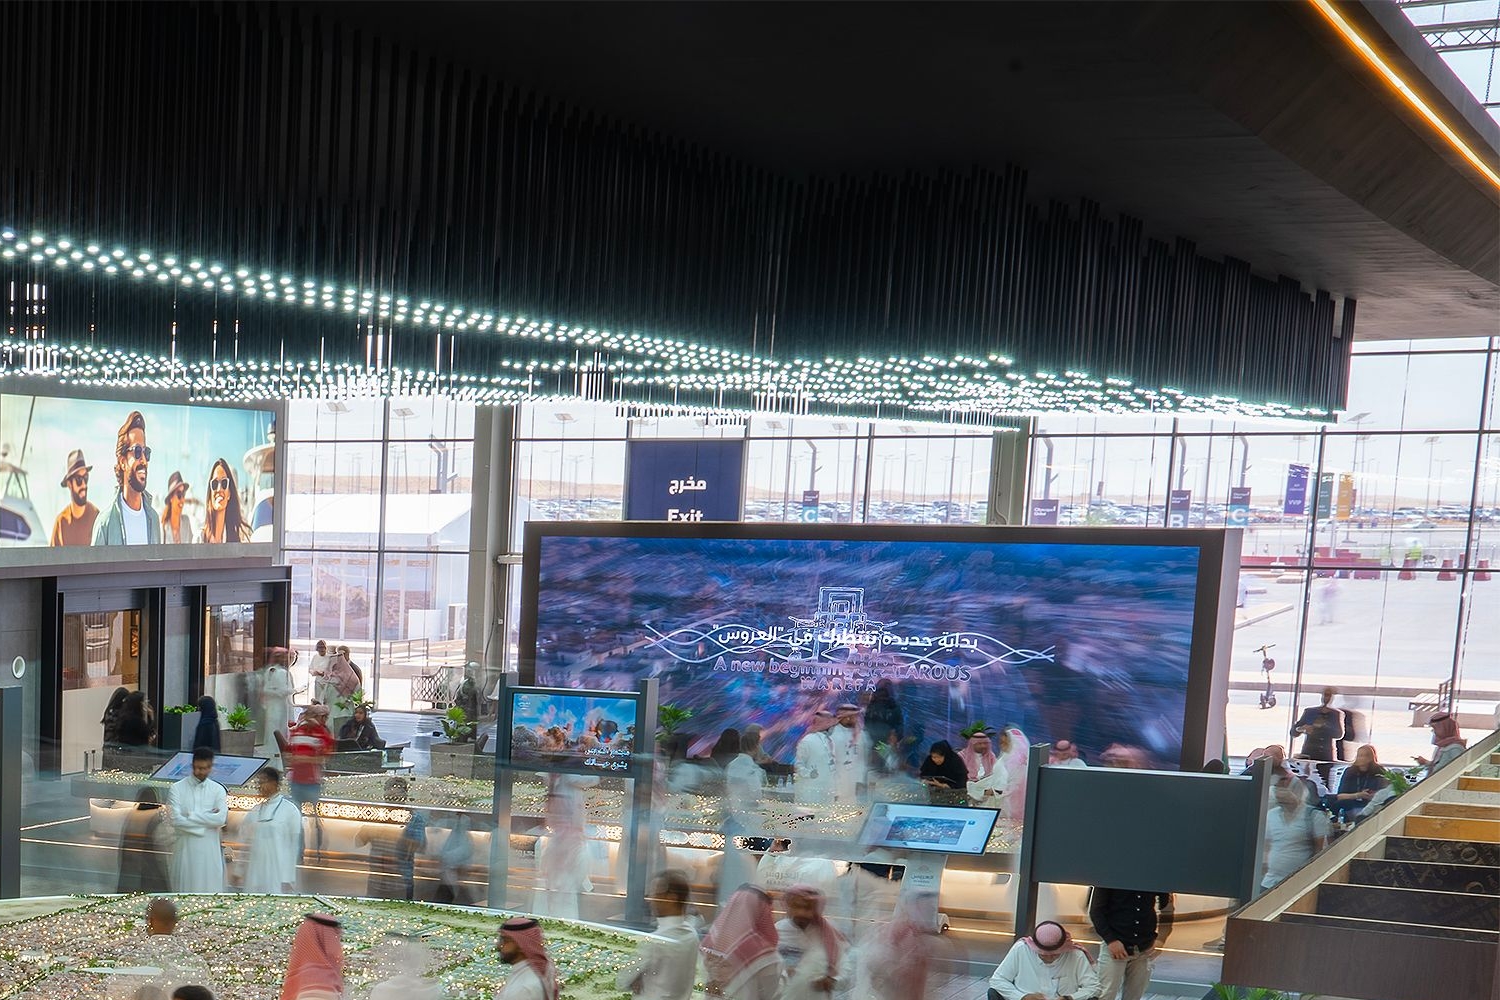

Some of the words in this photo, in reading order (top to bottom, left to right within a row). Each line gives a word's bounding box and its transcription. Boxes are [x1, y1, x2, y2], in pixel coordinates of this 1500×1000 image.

[668, 476, 707, 495] مخرج
[667, 508, 704, 523] Exit
[804, 509, 817, 523] C
[1170, 514, 1184, 528] B
[1232, 508, 1246, 523] C
[788, 628, 814, 651] في
[882, 631, 933, 651] جديدة
[938, 631, 978, 652] بداية
[713, 656, 727, 671] A
[731, 661, 766, 673] new
[800, 676, 877, 692] WAREFA
